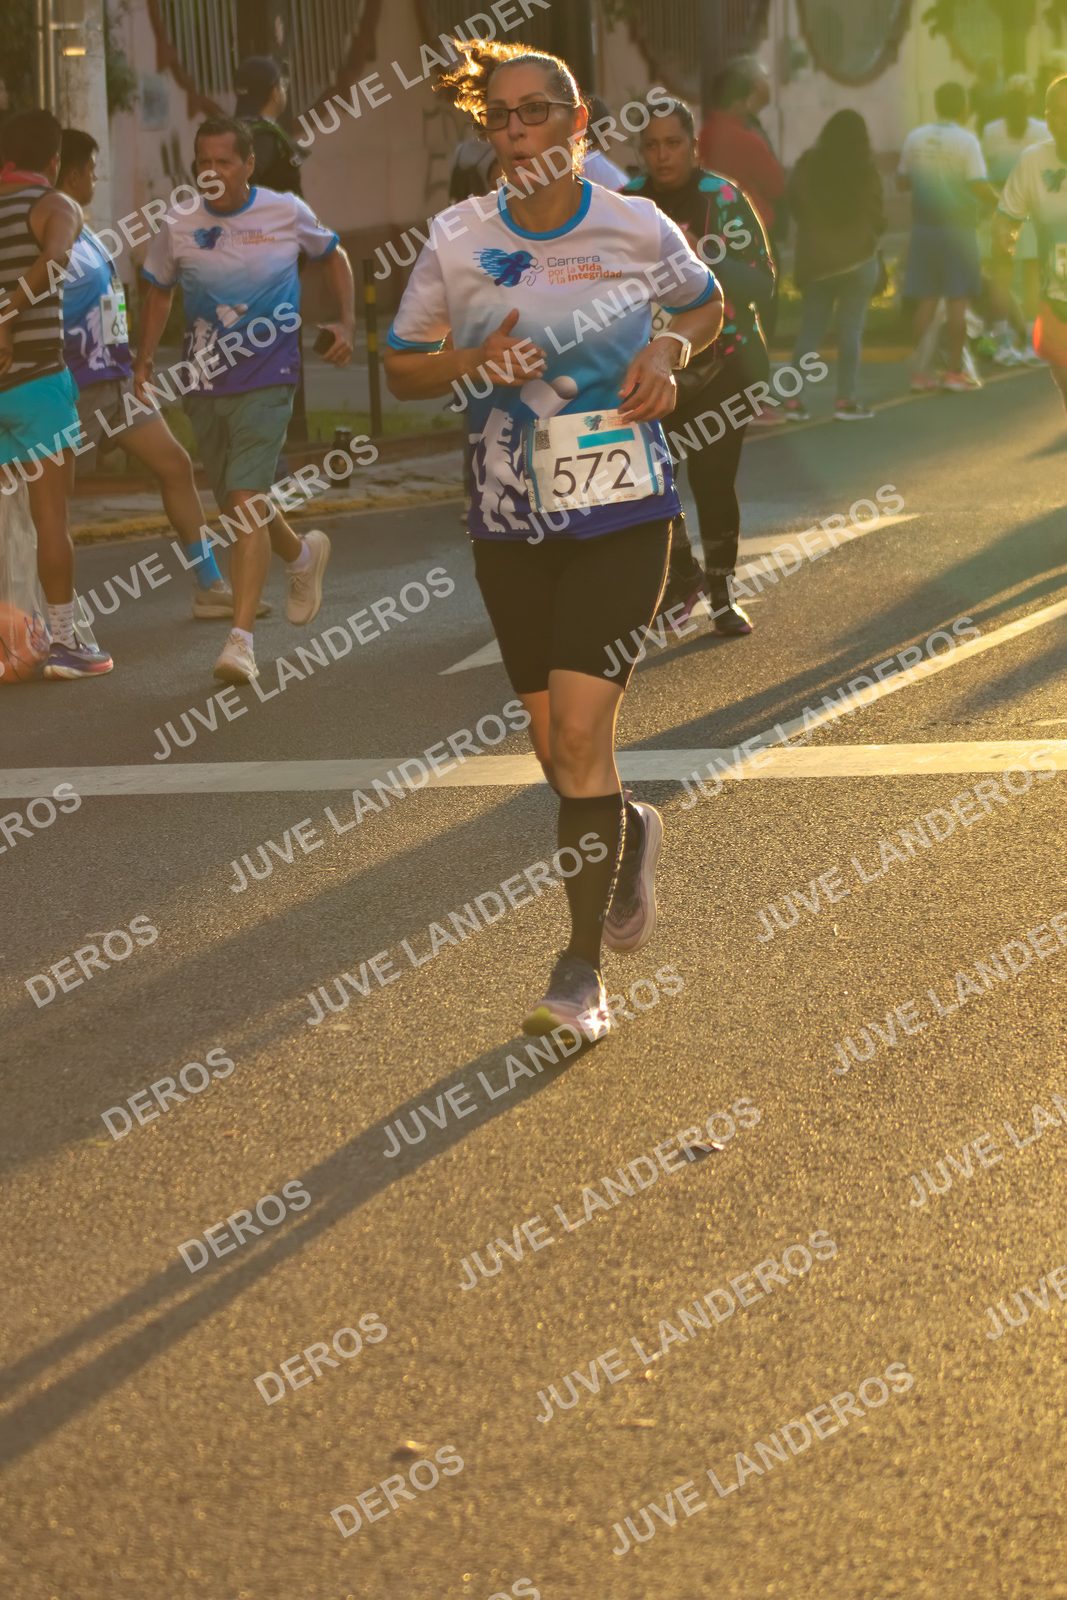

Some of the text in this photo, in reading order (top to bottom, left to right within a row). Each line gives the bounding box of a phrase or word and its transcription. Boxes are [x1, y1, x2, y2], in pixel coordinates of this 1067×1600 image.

[547, 255, 600, 268] Carrera
[548, 263, 602, 280] por la Vida
[556, 276, 566, 284] la
[552, 449, 635, 498] 572
